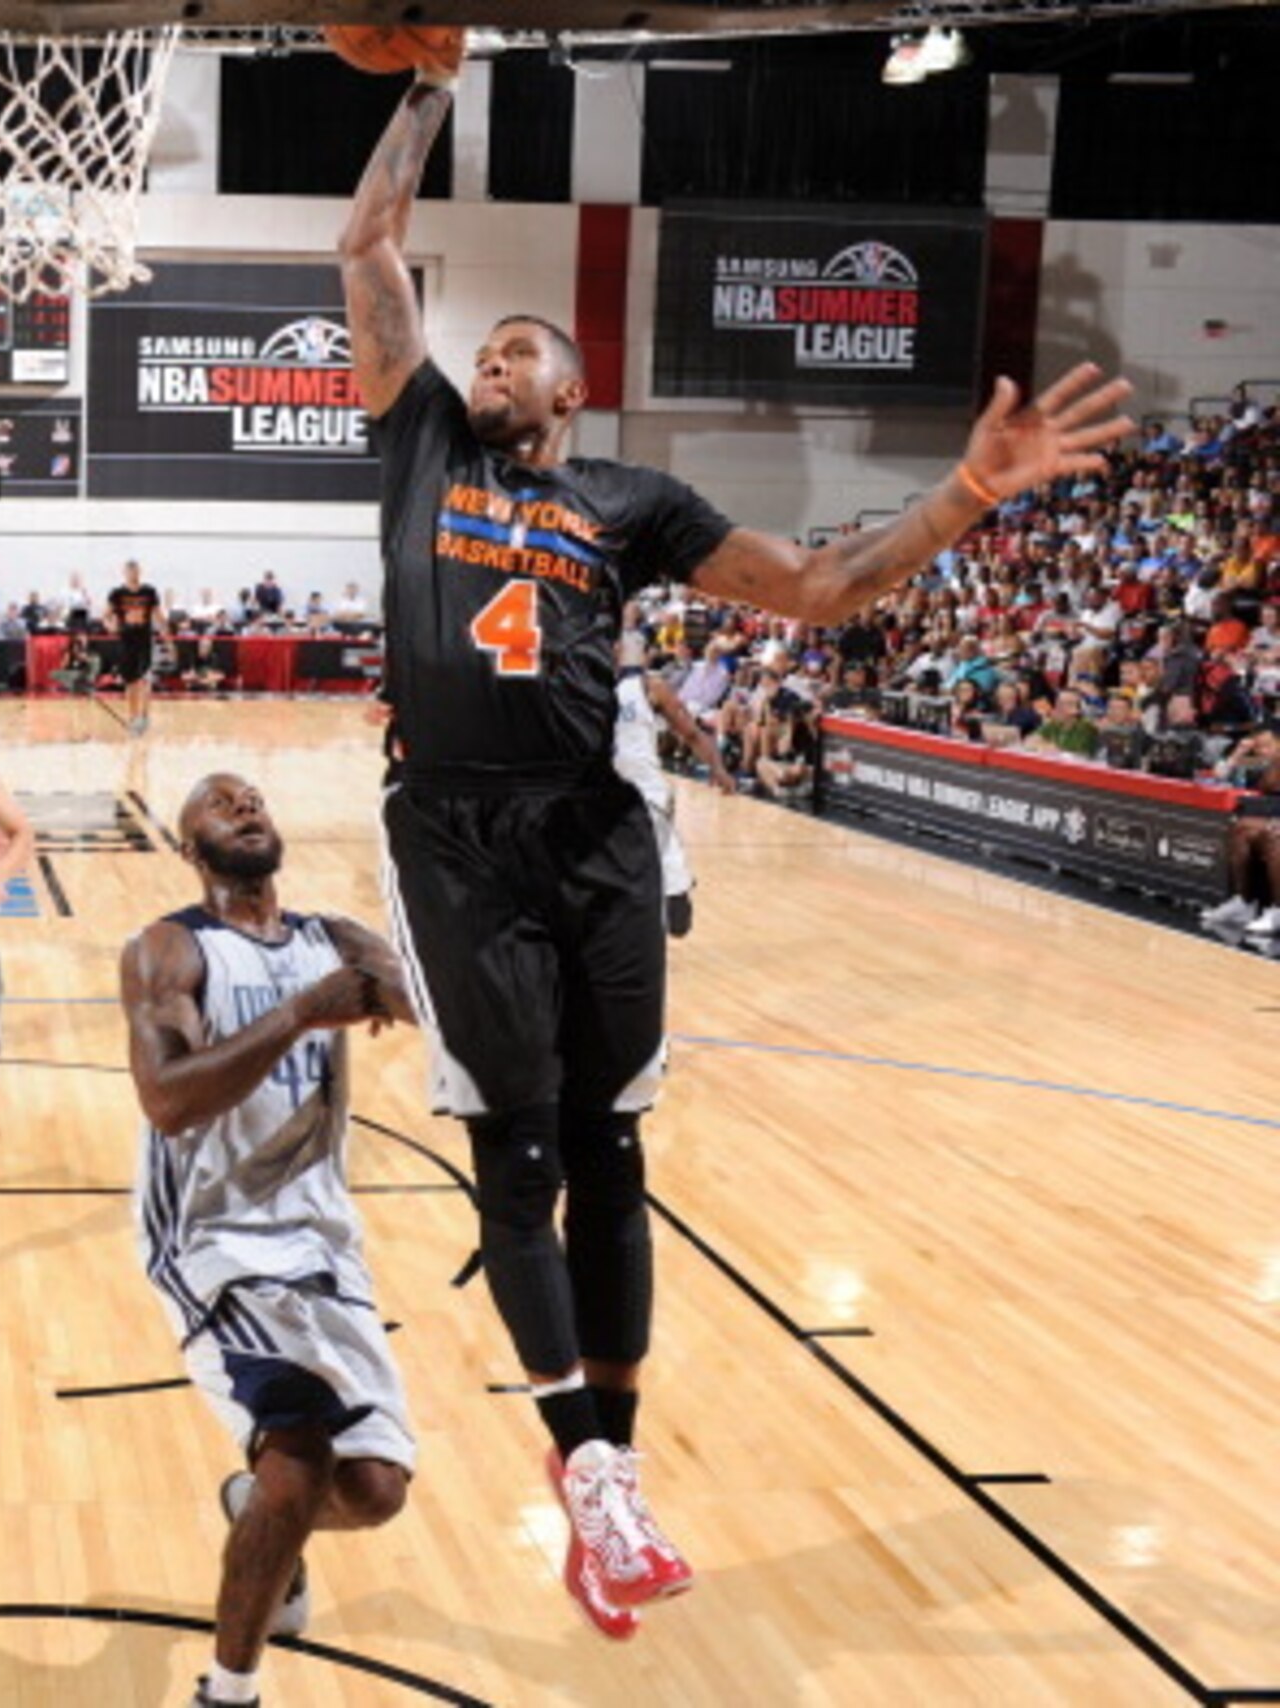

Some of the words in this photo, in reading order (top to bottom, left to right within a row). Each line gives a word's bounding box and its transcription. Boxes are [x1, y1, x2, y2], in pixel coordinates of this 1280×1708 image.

[716, 256, 820, 277] SAMSUNG
[138, 336, 256, 356] SAMSUNG
[795, 325, 915, 361] LEAGUE
[232, 406, 369, 443] LEAGUE
[444, 484, 512, 522] NEW
[520, 501, 602, 541] YORK
[434, 530, 592, 593] BASKETBALL
[471, 578, 542, 677] 4
